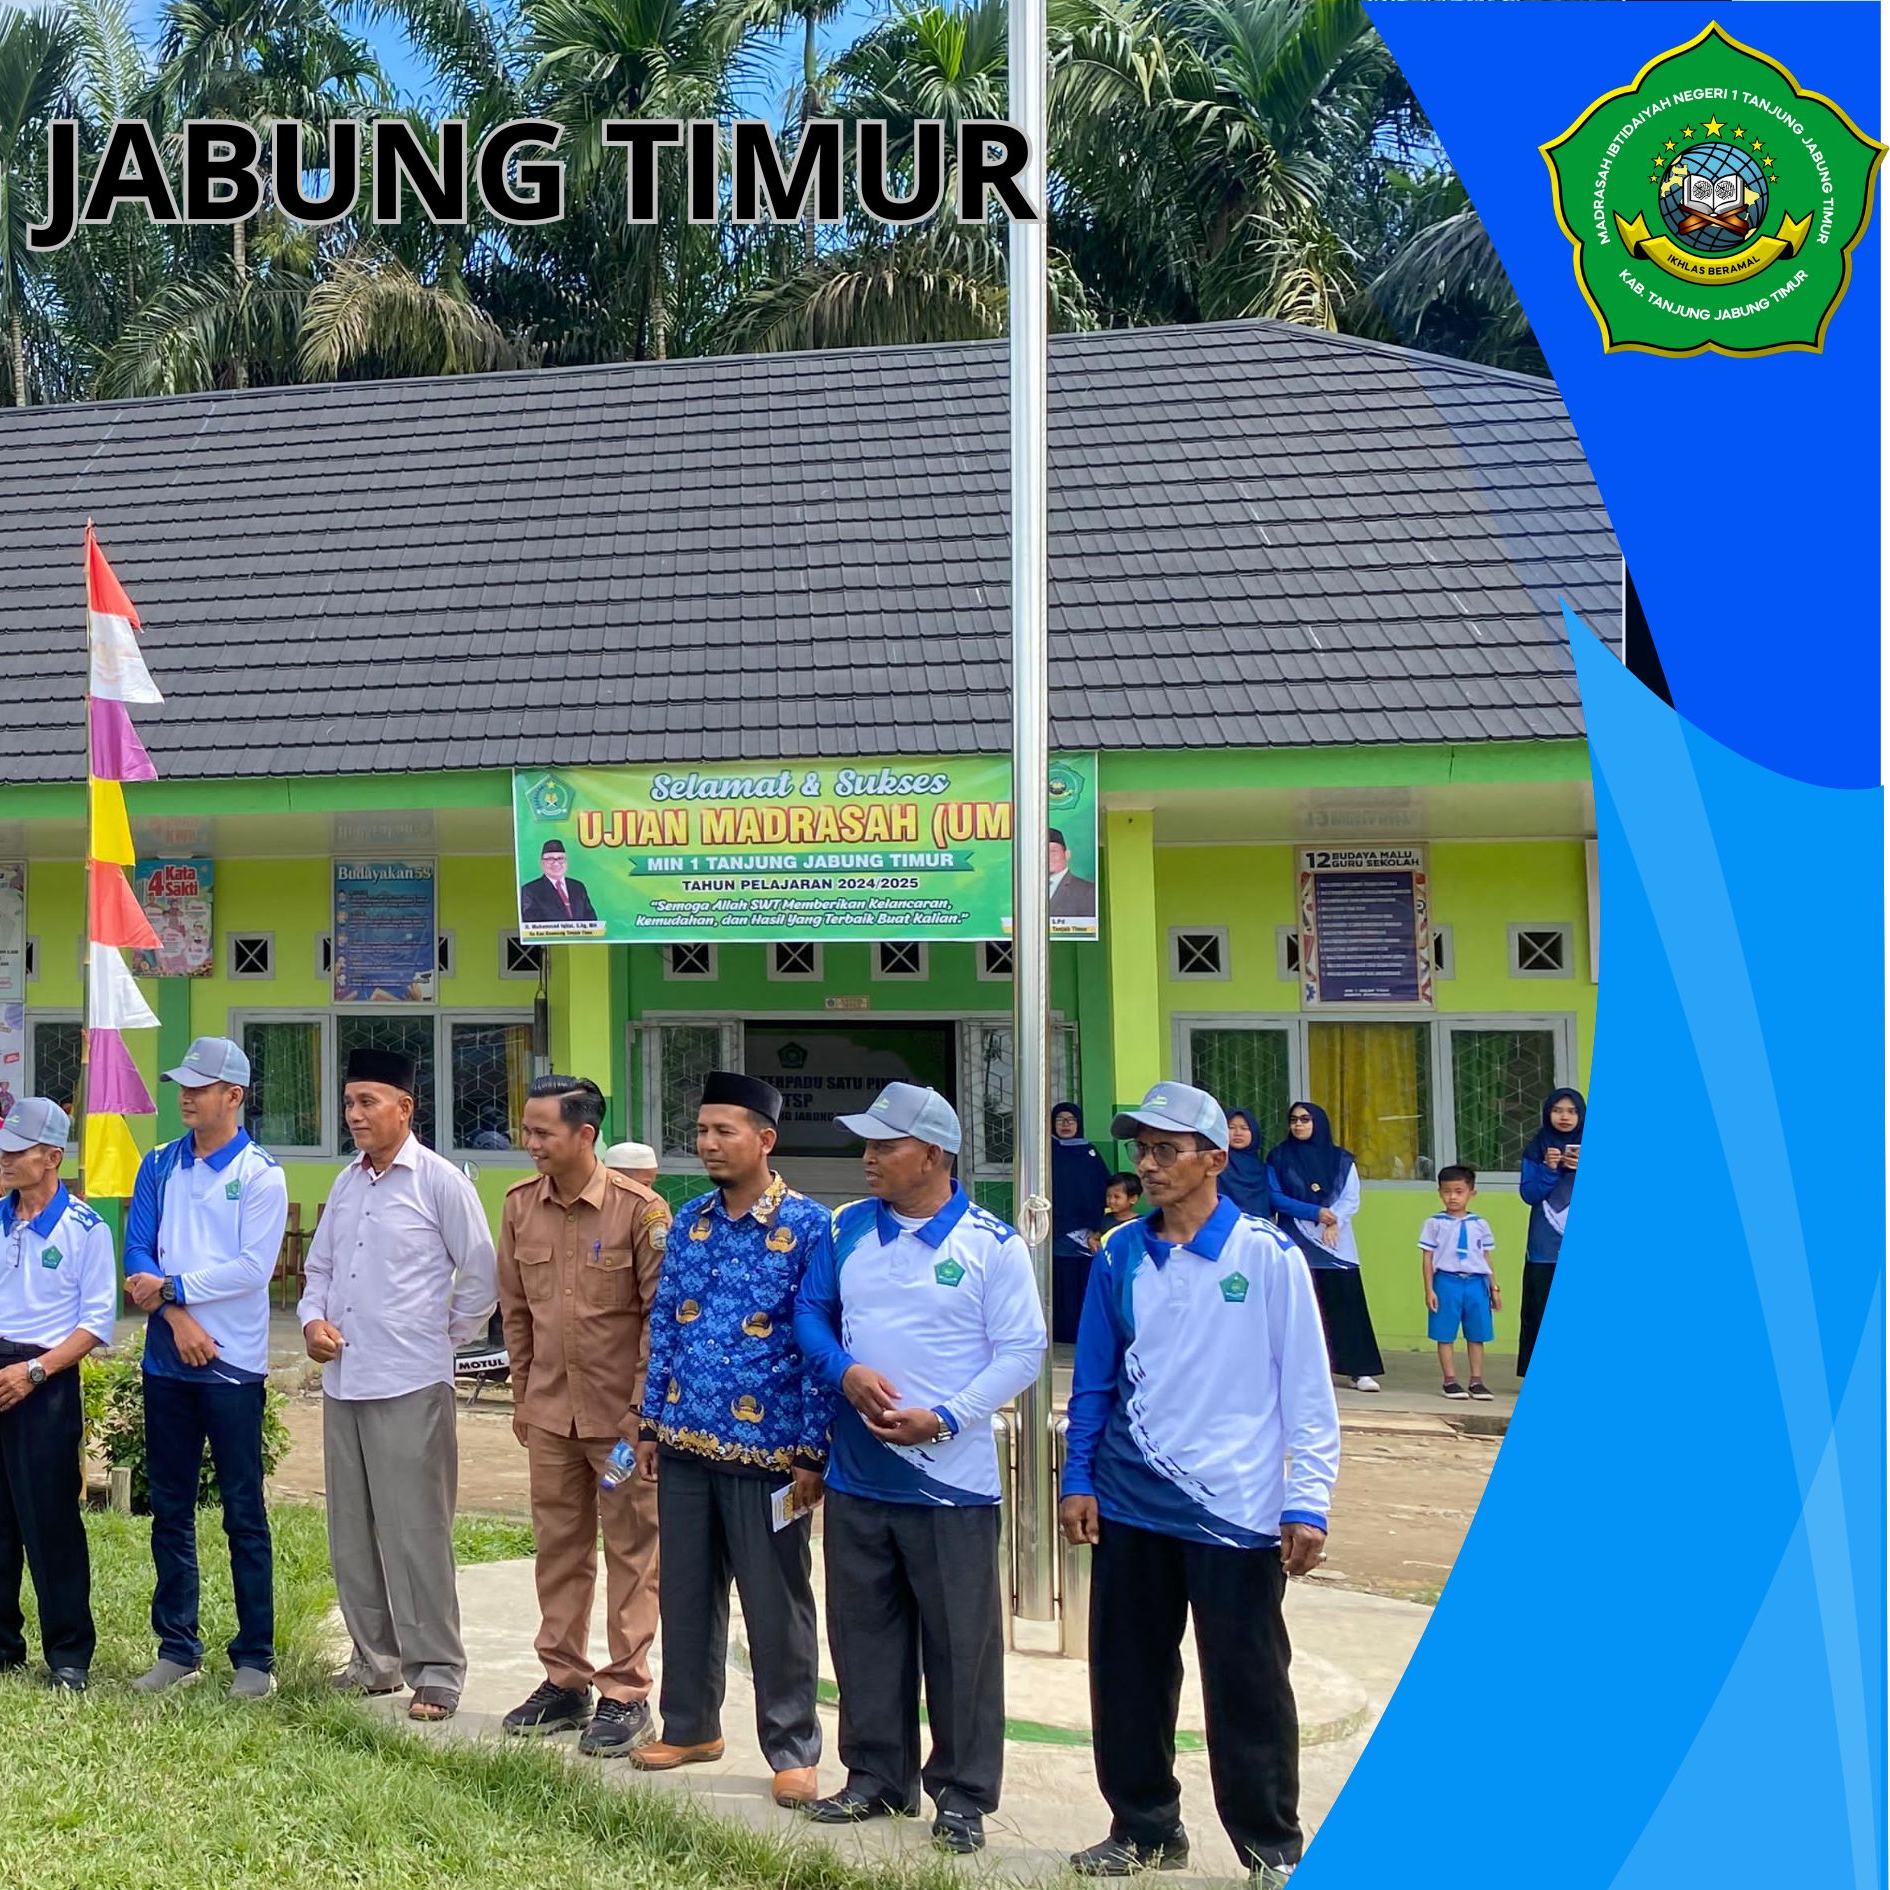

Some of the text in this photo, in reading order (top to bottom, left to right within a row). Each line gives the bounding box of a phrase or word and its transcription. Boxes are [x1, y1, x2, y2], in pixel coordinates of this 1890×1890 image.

[650, 767, 950, 801] Selamat & Sukses
[578, 809, 689, 848] UJIAN
[701, 804, 918, 845] MADRASAH
[648, 853, 954, 871] MIN 1 TANJUNG JABUNG TIMUR
[1306, 850, 1412, 868] 12 BUDAYA MALU
[1332, 858, 1420, 868] GURU SEKOLAH
[147, 865, 196, 896] 4 Kata
[338, 866, 413, 882] Budayakan
[165, 881, 198, 896] Sakti
[682, 878, 919, 891] TAHUN PELAJARAN 2024/2025
[712, 899, 748, 911] Allah
[749, 899, 782, 911] SWT
[782, 899, 866, 911] Memberikan
[868, 898, 952, 910] Kelancaran,
[635, 915, 718, 927] Kemudahan,
[721, 915, 745, 926] dan
[751, 914, 786, 926] Hasil
[787, 914, 821, 928] Yang
[824, 912, 875, 925] Terbaik
[876, 912, 910, 925] Buat
[827, 1077, 862, 1089] SATU
[782, 1093, 813, 1107] TSP
[459, 1359, 505, 1369] MOTUL
